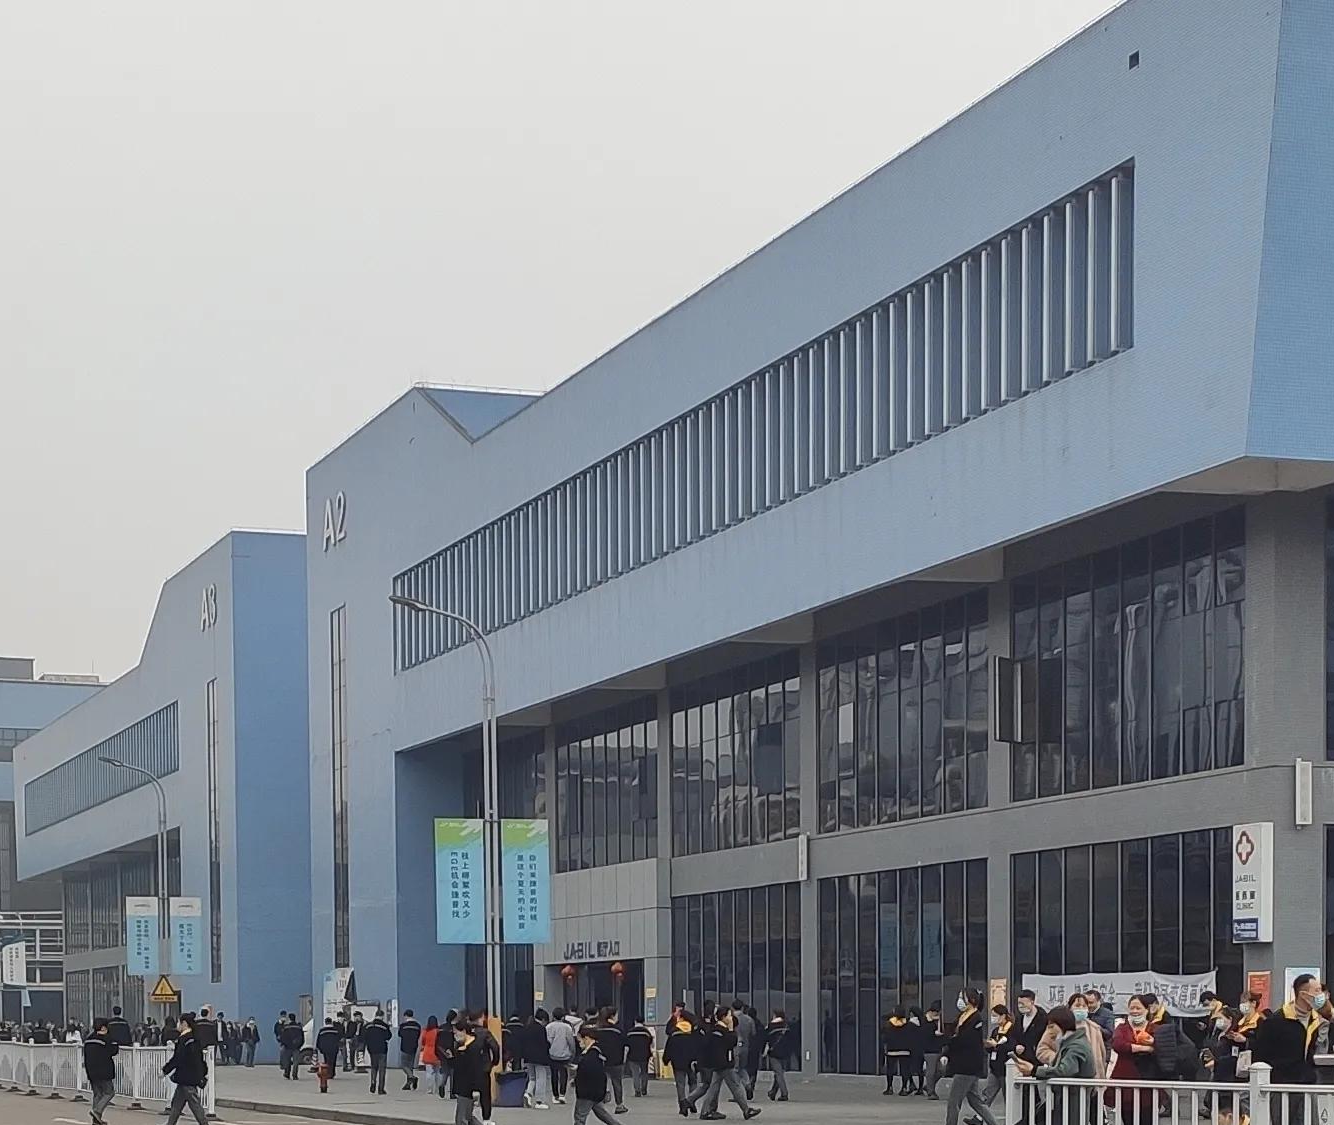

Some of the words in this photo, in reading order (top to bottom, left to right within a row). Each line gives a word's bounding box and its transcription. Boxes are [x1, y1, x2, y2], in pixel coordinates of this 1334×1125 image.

[322, 490, 347, 553] A2
[200, 583, 218, 632] A3
[1235, 874, 1256, 883] JABIL
[563, 941, 595, 961] JABIL
